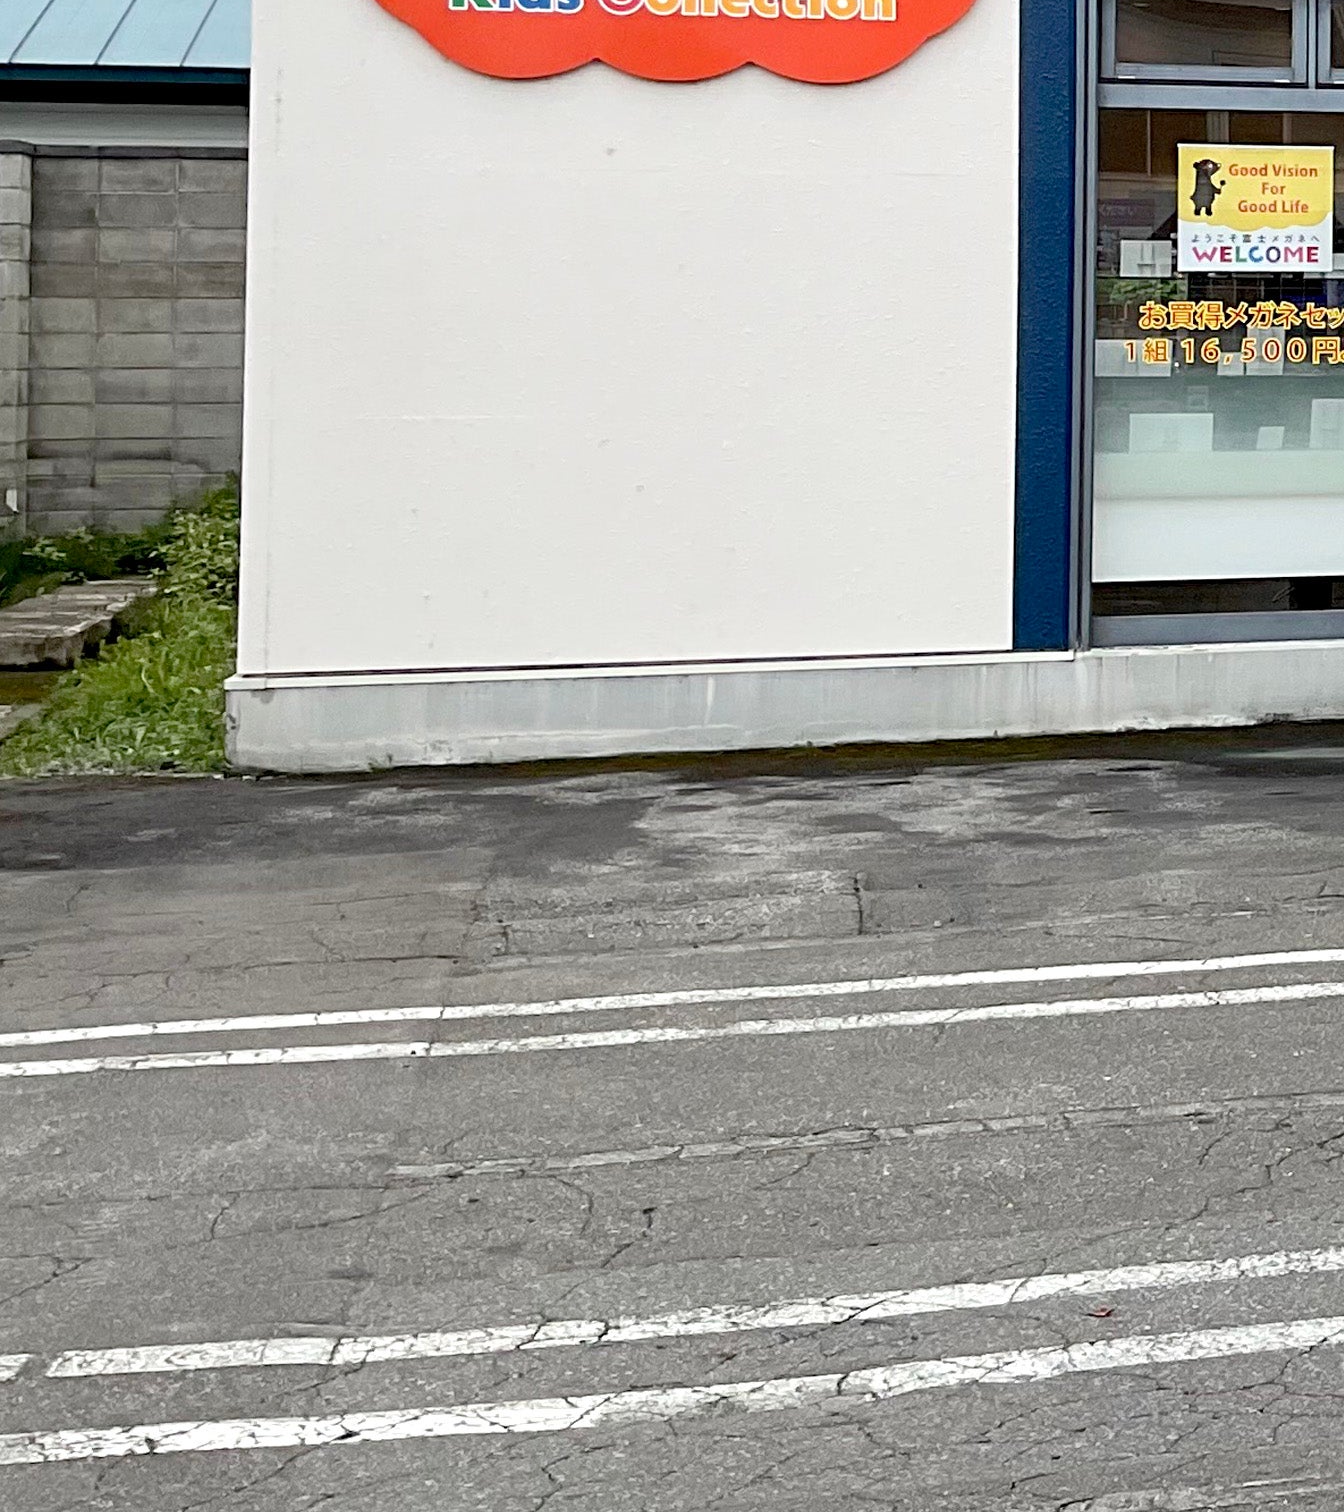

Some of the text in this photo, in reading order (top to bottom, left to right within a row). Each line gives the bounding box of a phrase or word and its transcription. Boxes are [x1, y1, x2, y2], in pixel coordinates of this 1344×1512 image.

[1229, 163, 1318, 177] Good Vision
[1261, 182, 1286, 195] For
[1238, 200, 1309, 213] Good Life
[1192, 246, 1319, 263] WELCOME
